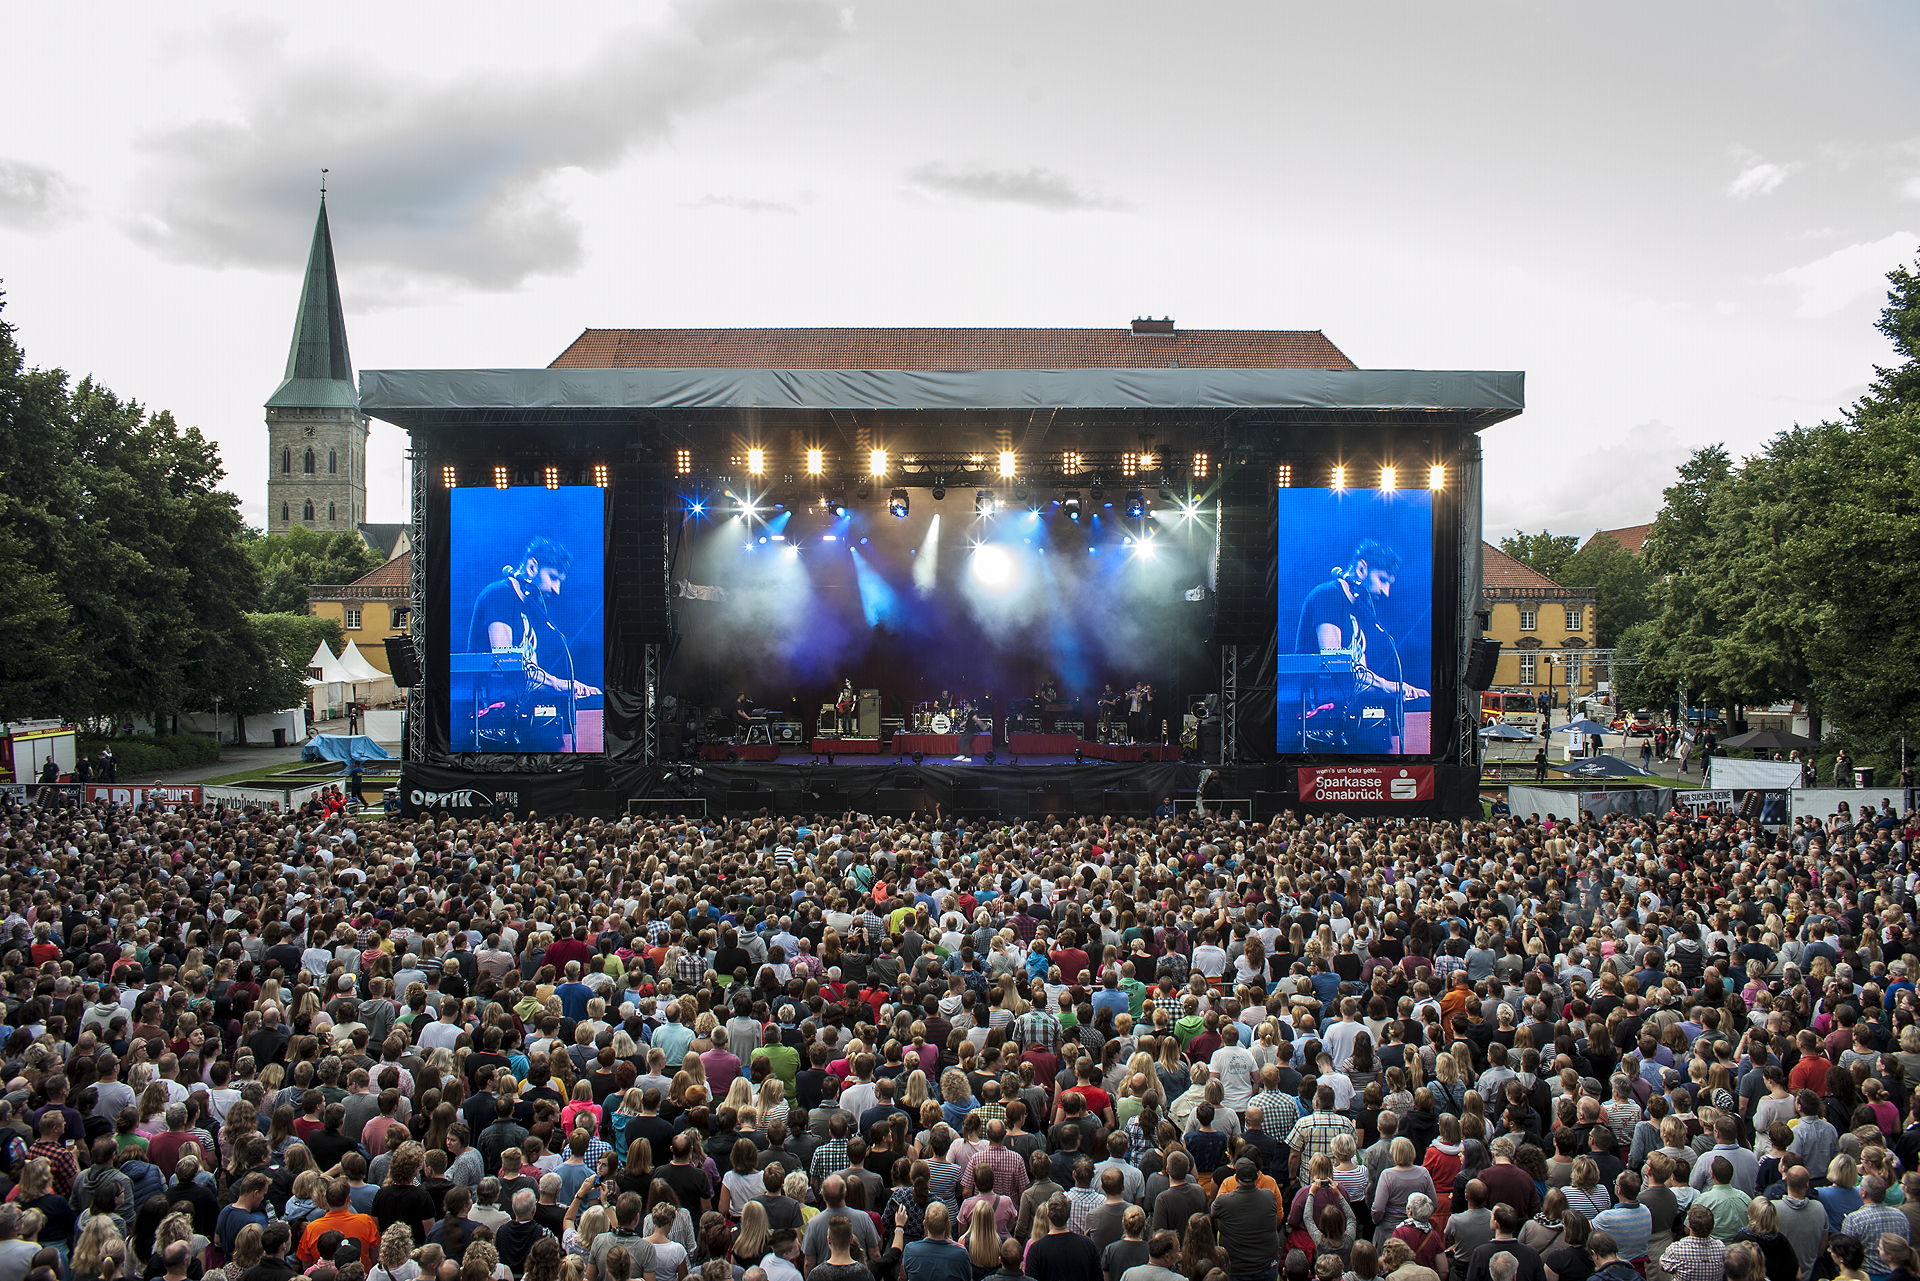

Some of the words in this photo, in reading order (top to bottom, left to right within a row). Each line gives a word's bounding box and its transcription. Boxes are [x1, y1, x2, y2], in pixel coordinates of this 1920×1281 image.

[1316, 776, 1382, 789] Sparkasse
[410, 789, 473, 808] OPTIK
[1315, 789, 1384, 800] Osnabrück
[1691, 793, 1713, 801] SUCHEN
[1714, 791, 1731, 800] DEINE
